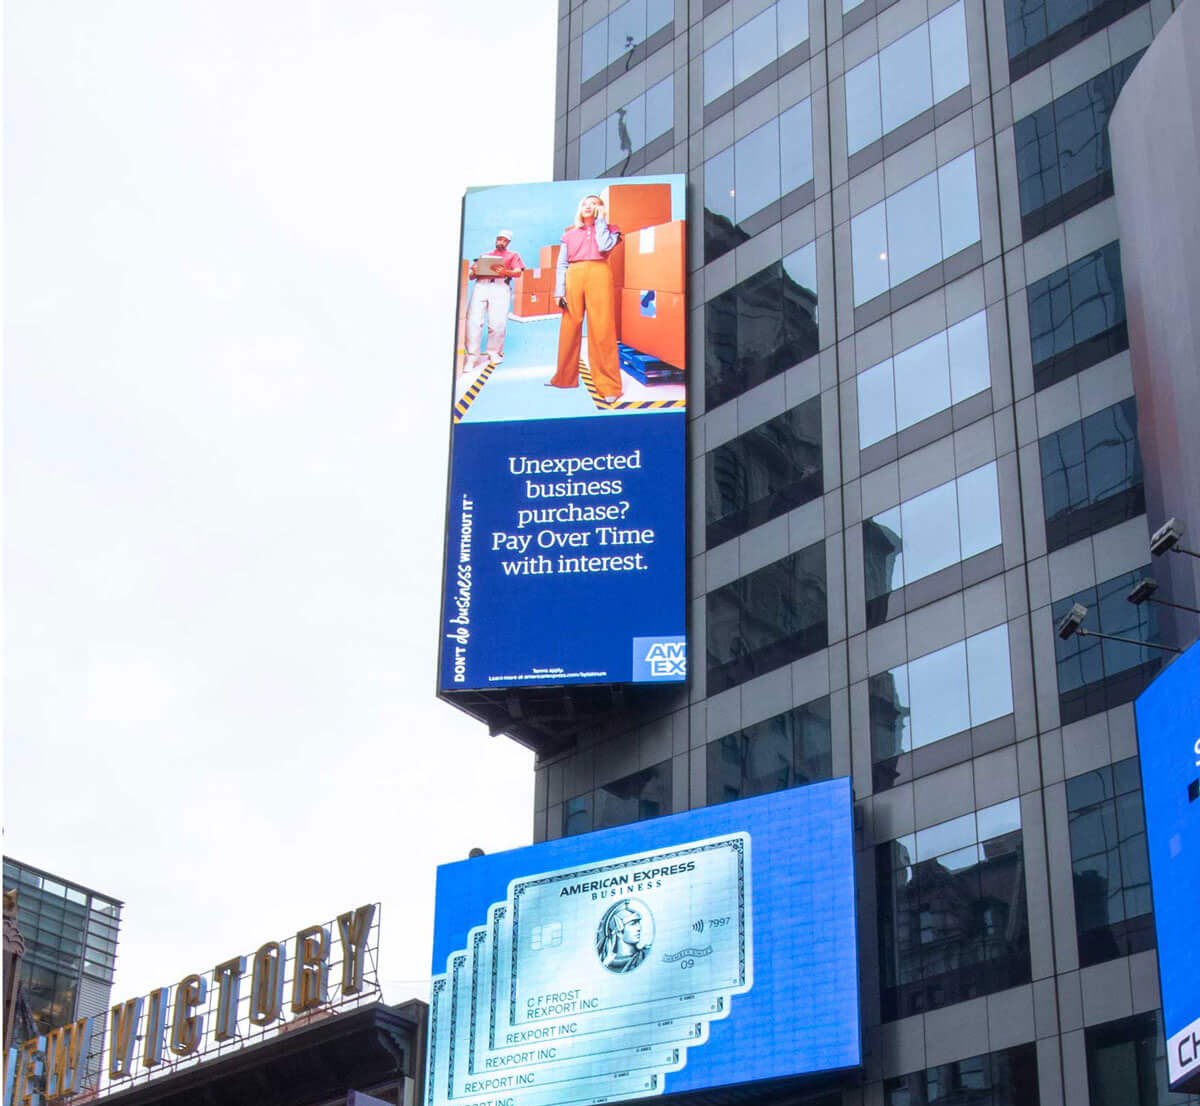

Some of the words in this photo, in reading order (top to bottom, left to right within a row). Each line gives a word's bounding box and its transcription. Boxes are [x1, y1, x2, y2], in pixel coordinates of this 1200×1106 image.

[508, 450, 642, 476] Unexpected
[525, 479, 623, 499] business
[462, 499, 474, 510] IT
[517, 501, 630, 528] purchase?
[458, 513, 473, 563] WITHOUT
[491, 532, 532, 553] Pay
[537, 530, 591, 549] Over
[596, 527, 655, 546] Time
[502, 556, 553, 576] with
[558, 552, 648, 574] interest.
[449, 565, 473, 624] business
[446, 625, 471, 645] do
[645, 643, 687, 662] AM
[453, 647, 468, 682] DON'T
[651, 660, 687, 676] EX
[559, 875, 629, 897] AMERICAN
[633, 861, 696, 882] EXPRESS
[591, 879, 663, 900] BUSINESS
[708, 917, 731, 929] 7997
[680, 960, 695, 970] 09
[109, 903, 376, 1080] VICTORY
[527, 998, 535, 1008] C
[537, 997, 544, 1006] F
[543, 989, 581, 1005] FROST
[527, 1001, 578, 1019] REXPORT
[580, 998, 599, 1010] INC
[506, 1026, 556, 1044] REXPORT
[558, 1023, 578, 1034] INC
[485, 1051, 535, 1068] REXPORT
[537, 1048, 557, 1059] INC
[464, 1076, 514, 1093] REXPORT
[516, 1073, 535, 1084] INC
